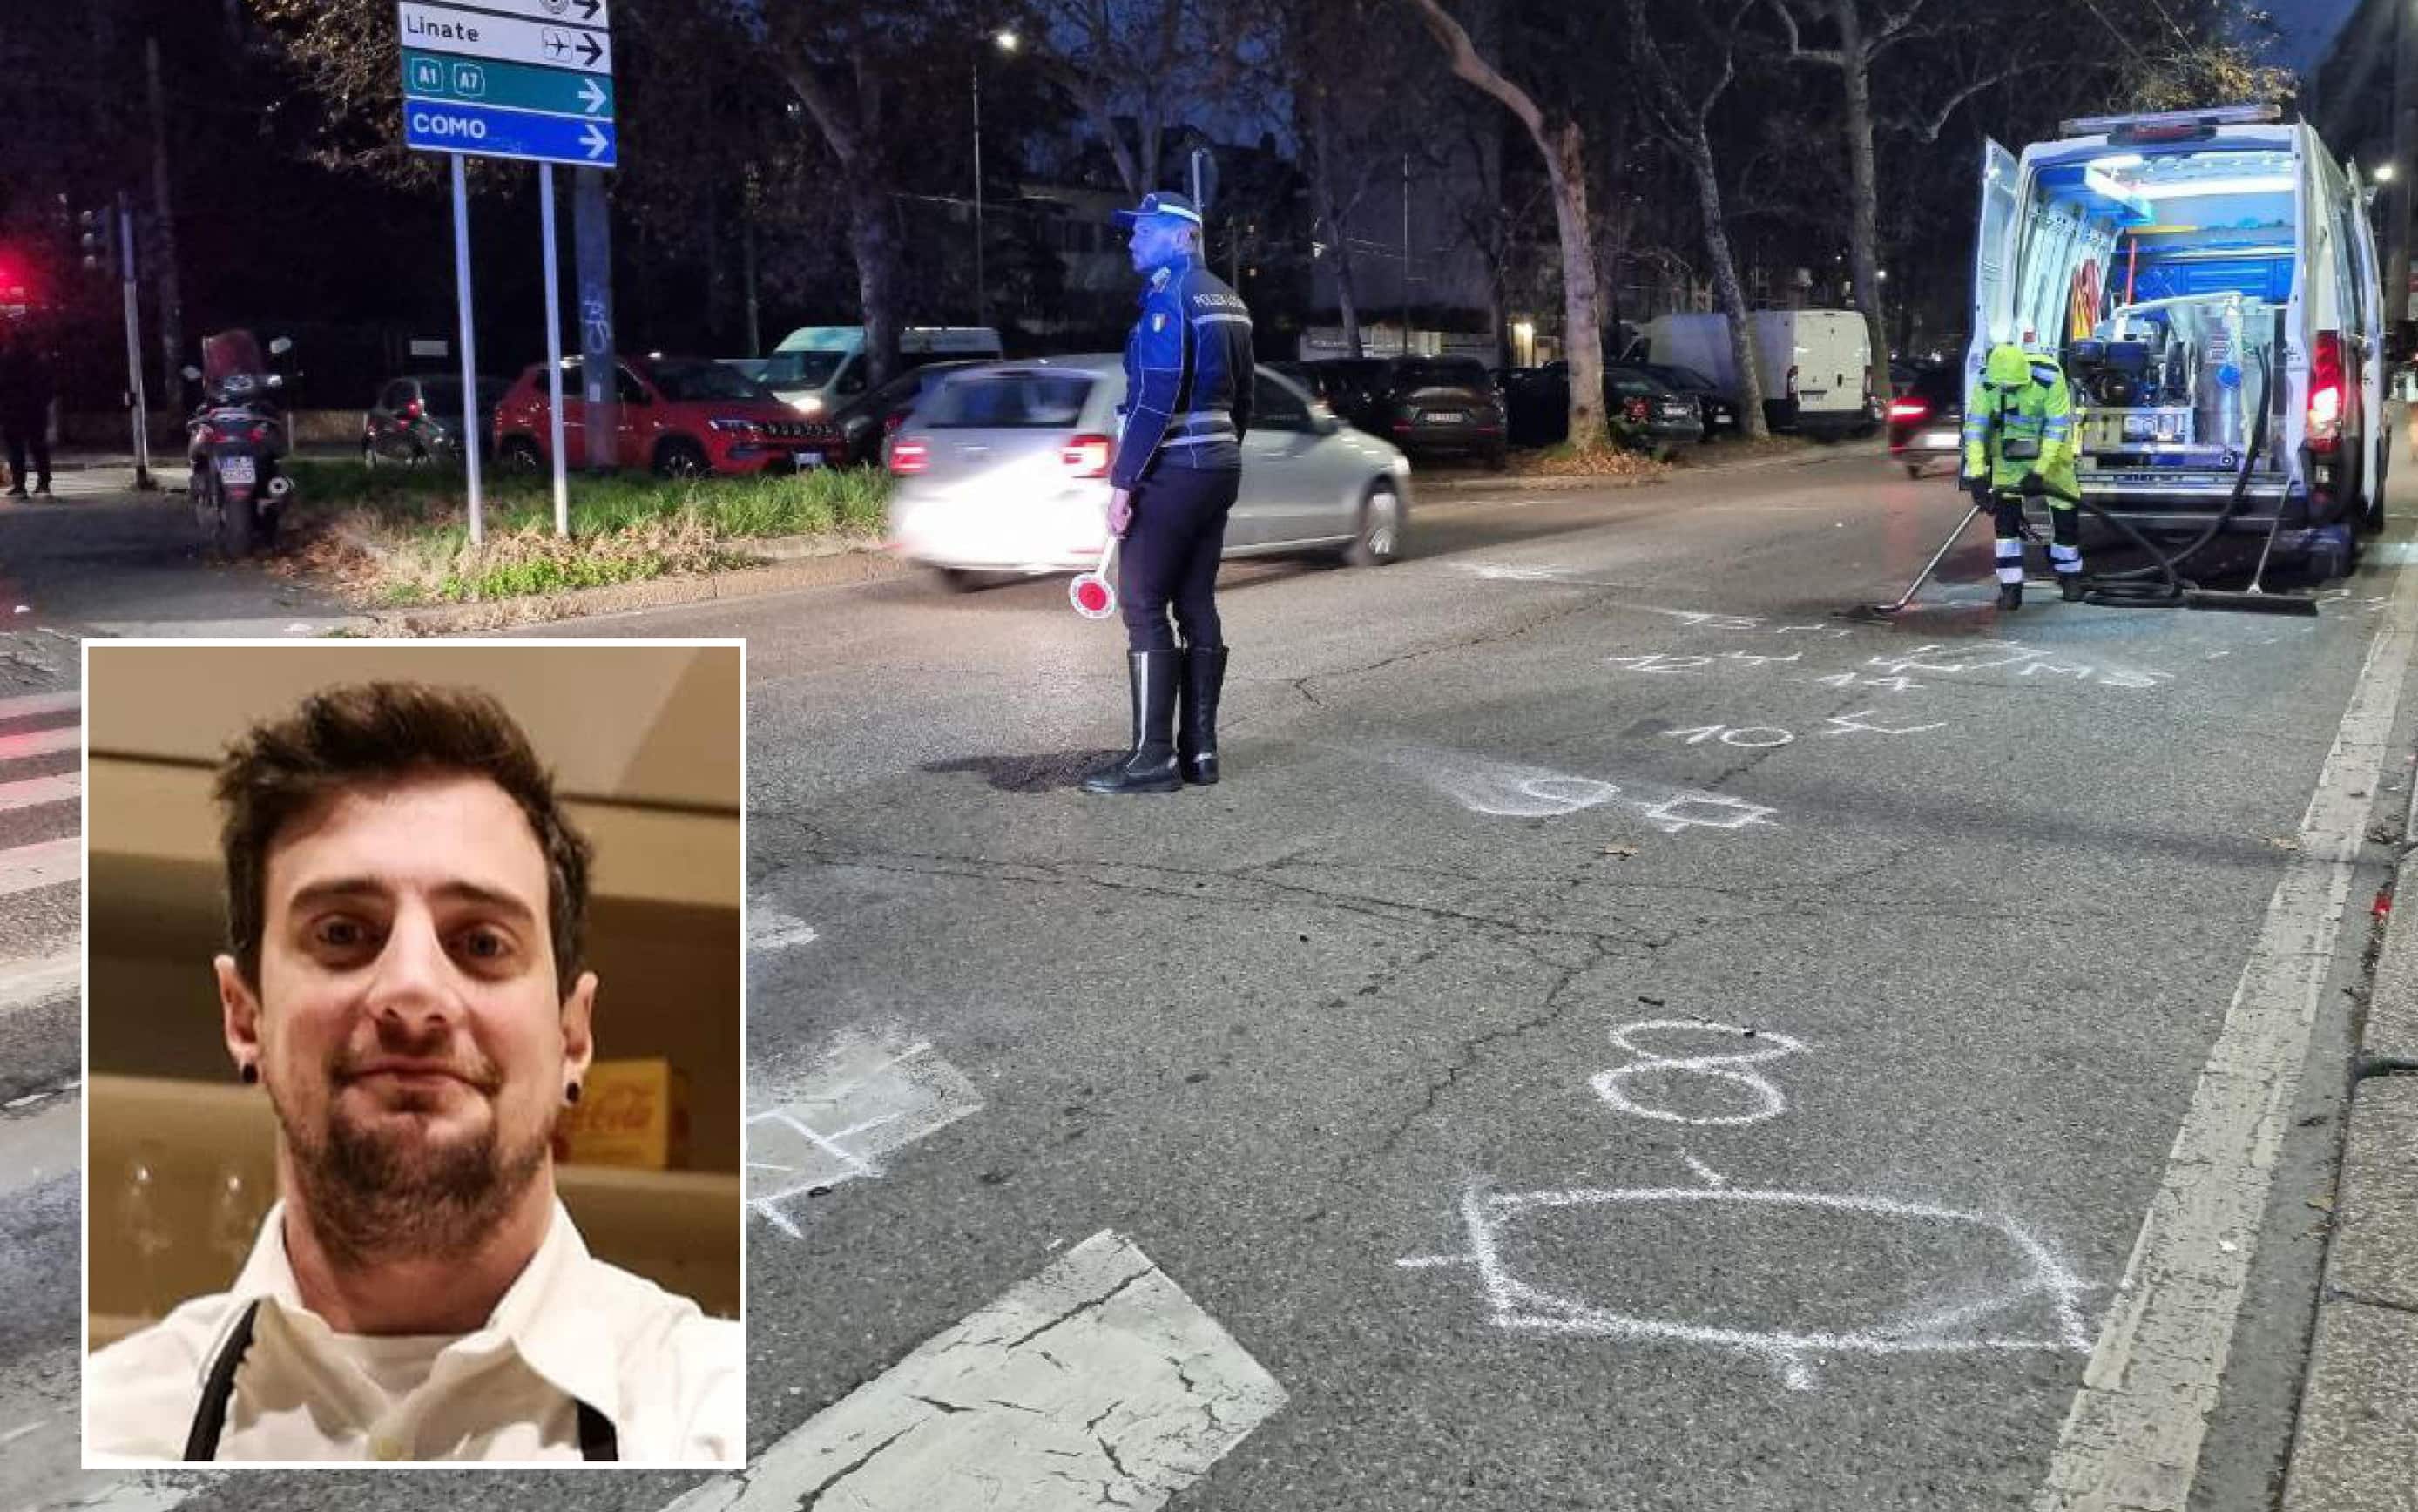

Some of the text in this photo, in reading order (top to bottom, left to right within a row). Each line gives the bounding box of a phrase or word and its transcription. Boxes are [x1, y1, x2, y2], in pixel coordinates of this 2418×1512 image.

[407, 14, 479, 42] Linate
[419, 66, 436, 84] A1
[460, 71, 477, 89] A7
[413, 112, 486, 138] COMO
[1658, 724, 1794, 746] 10
[1591, 1018, 1812, 1125] 8
